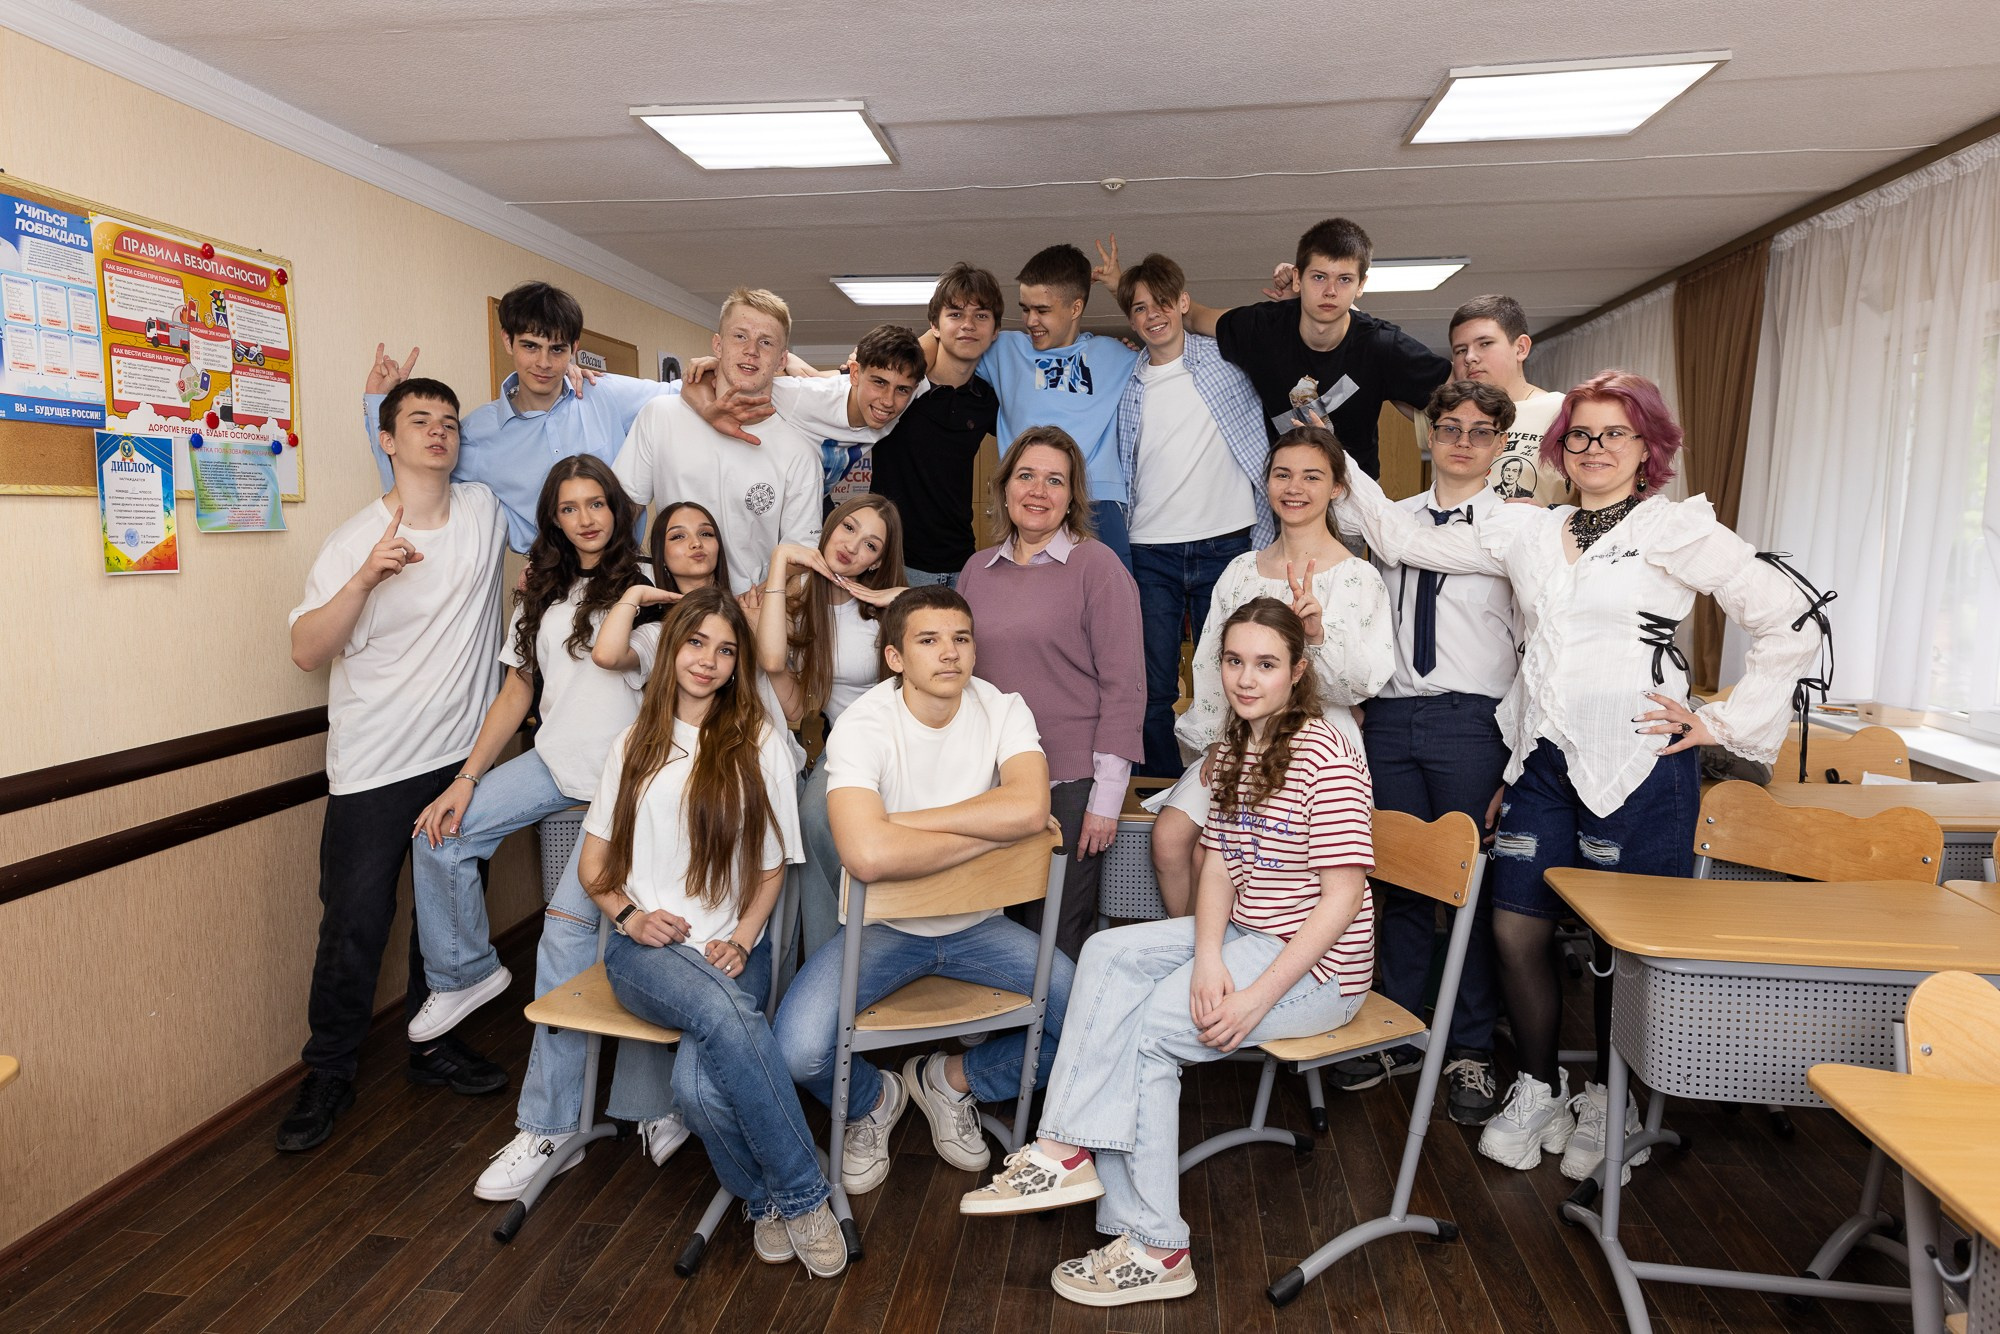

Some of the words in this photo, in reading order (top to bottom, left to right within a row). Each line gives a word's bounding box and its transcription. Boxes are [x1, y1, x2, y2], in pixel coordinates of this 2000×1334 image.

[14, 201, 68, 228] УЧИТЬСЯ
[15, 218, 89, 247] ПОБЕЖДАТЬ
[122, 236, 182, 263] ПРАВИЛА
[183, 253, 267, 287] БЕЗОПАСНОСТИ
[105, 262, 116, 271] КАК
[116, 265, 133, 275] ВЕСТИ
[133, 269, 148, 278] СЕБЯ
[147, 272, 159, 281] ПРИ
[124, 349, 141, 357] ВЕСТИ
[141, 351, 155, 359] СЕБЯ
[580, 351, 602, 369] России
[14, 402, 27, 413] ВЫ
[34, 404, 71, 417] БУДУЩЕЕ
[71, 408, 101, 420] РОССИИ!
[148, 423, 180, 434] ДОРОГИЕ
[206, 428, 229, 438] БУДЬТЕ
[110, 460, 155, 474] ДИПЛОМ
